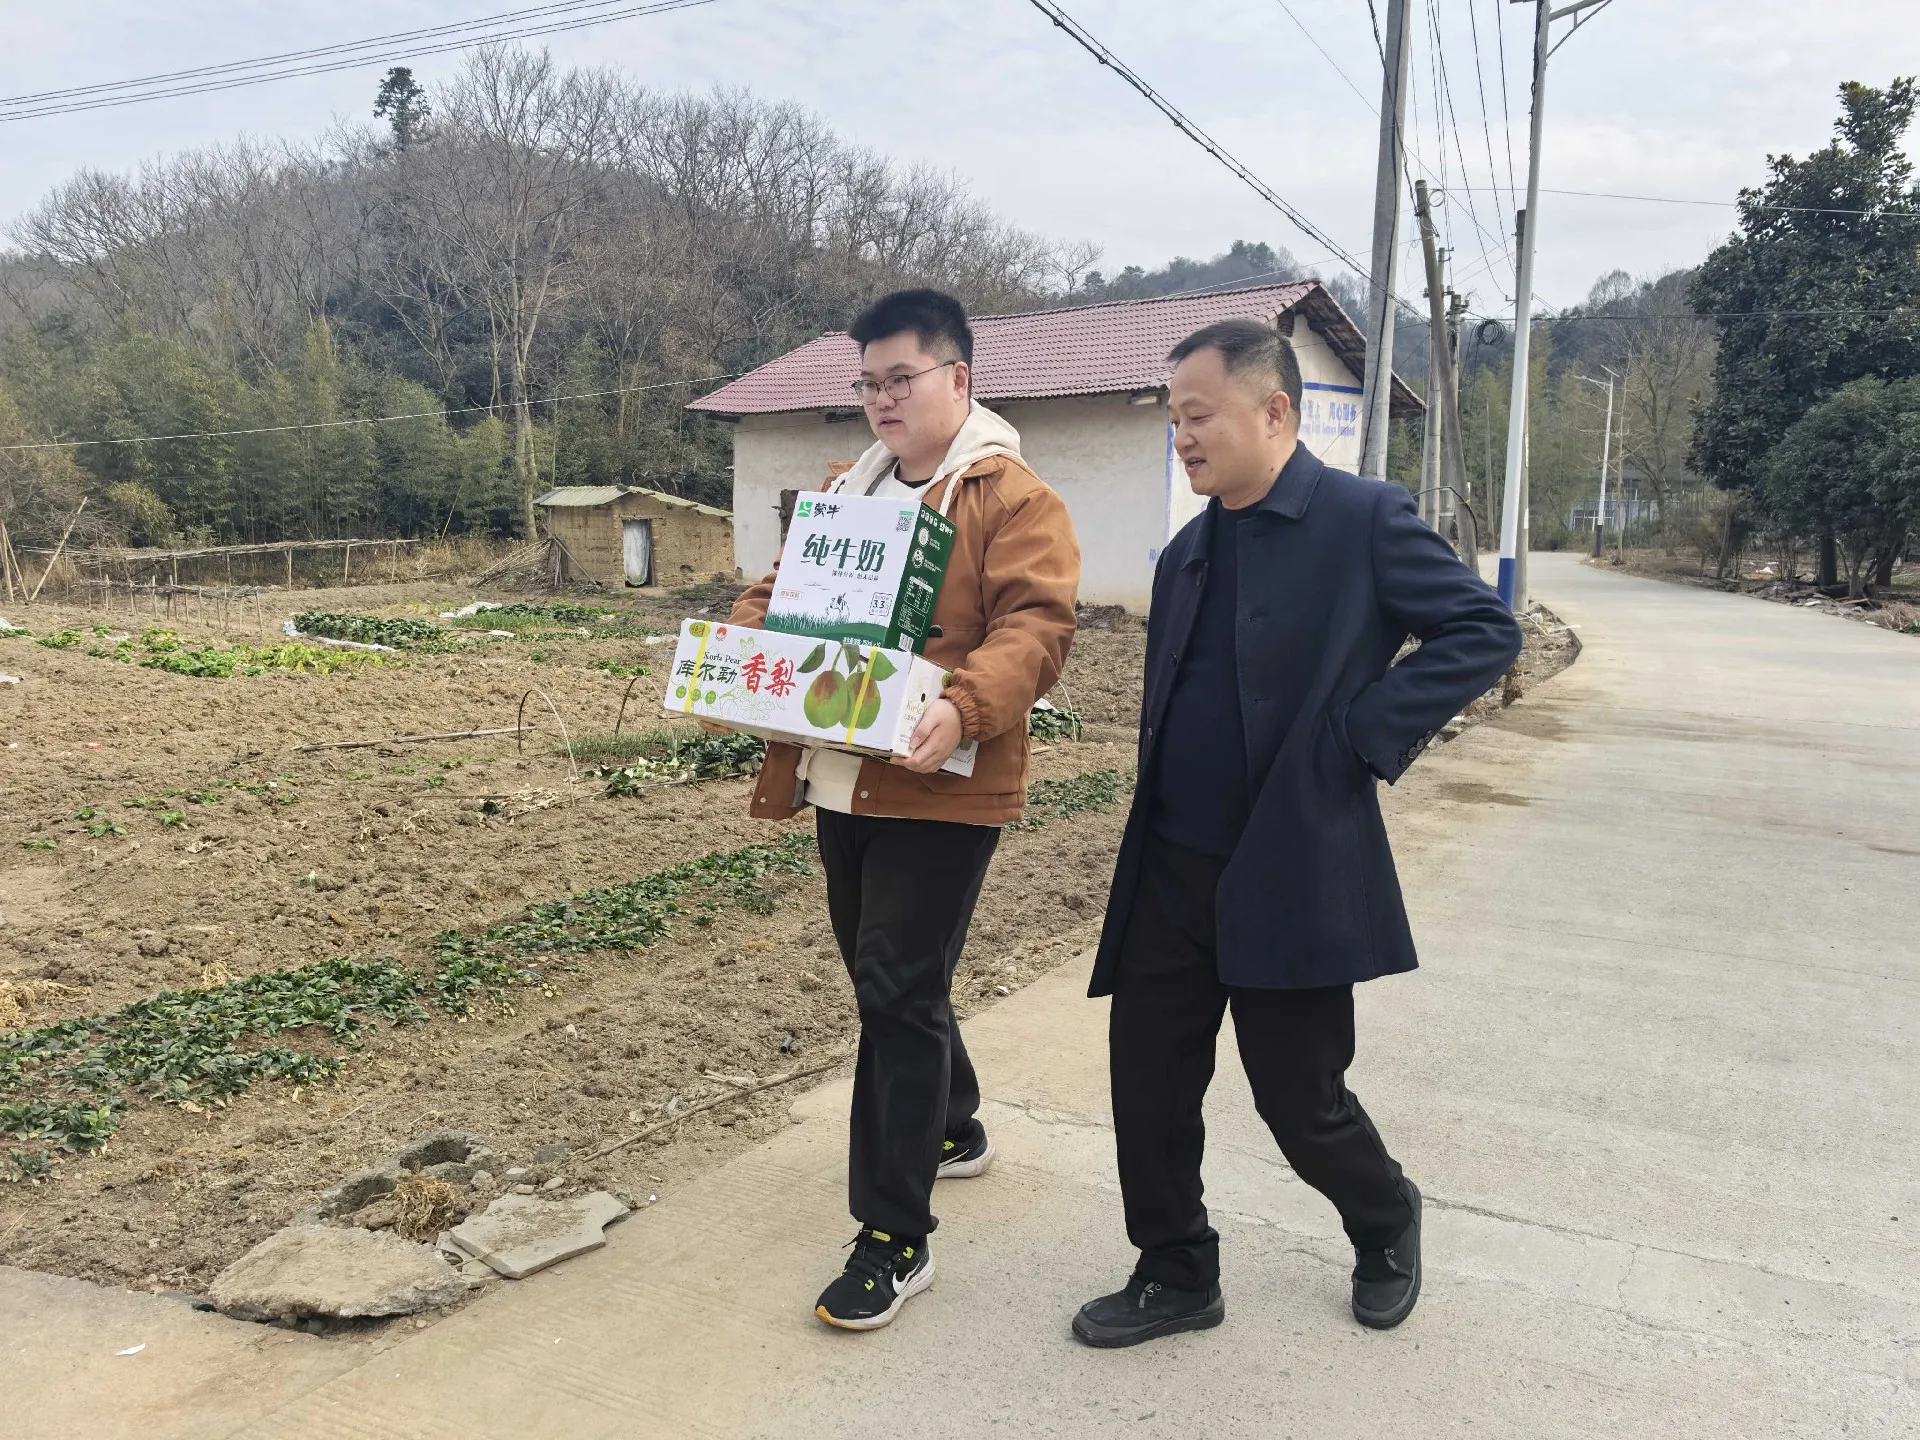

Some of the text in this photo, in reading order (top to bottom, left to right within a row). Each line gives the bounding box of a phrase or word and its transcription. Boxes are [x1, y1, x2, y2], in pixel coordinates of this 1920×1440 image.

[813, 503, 841, 519] 蒙牛
[800, 533, 886, 573] 纯牛奶
[703, 651, 742, 665] Korla Pear
[675, 652, 797, 698] 库尔勒 香梨
